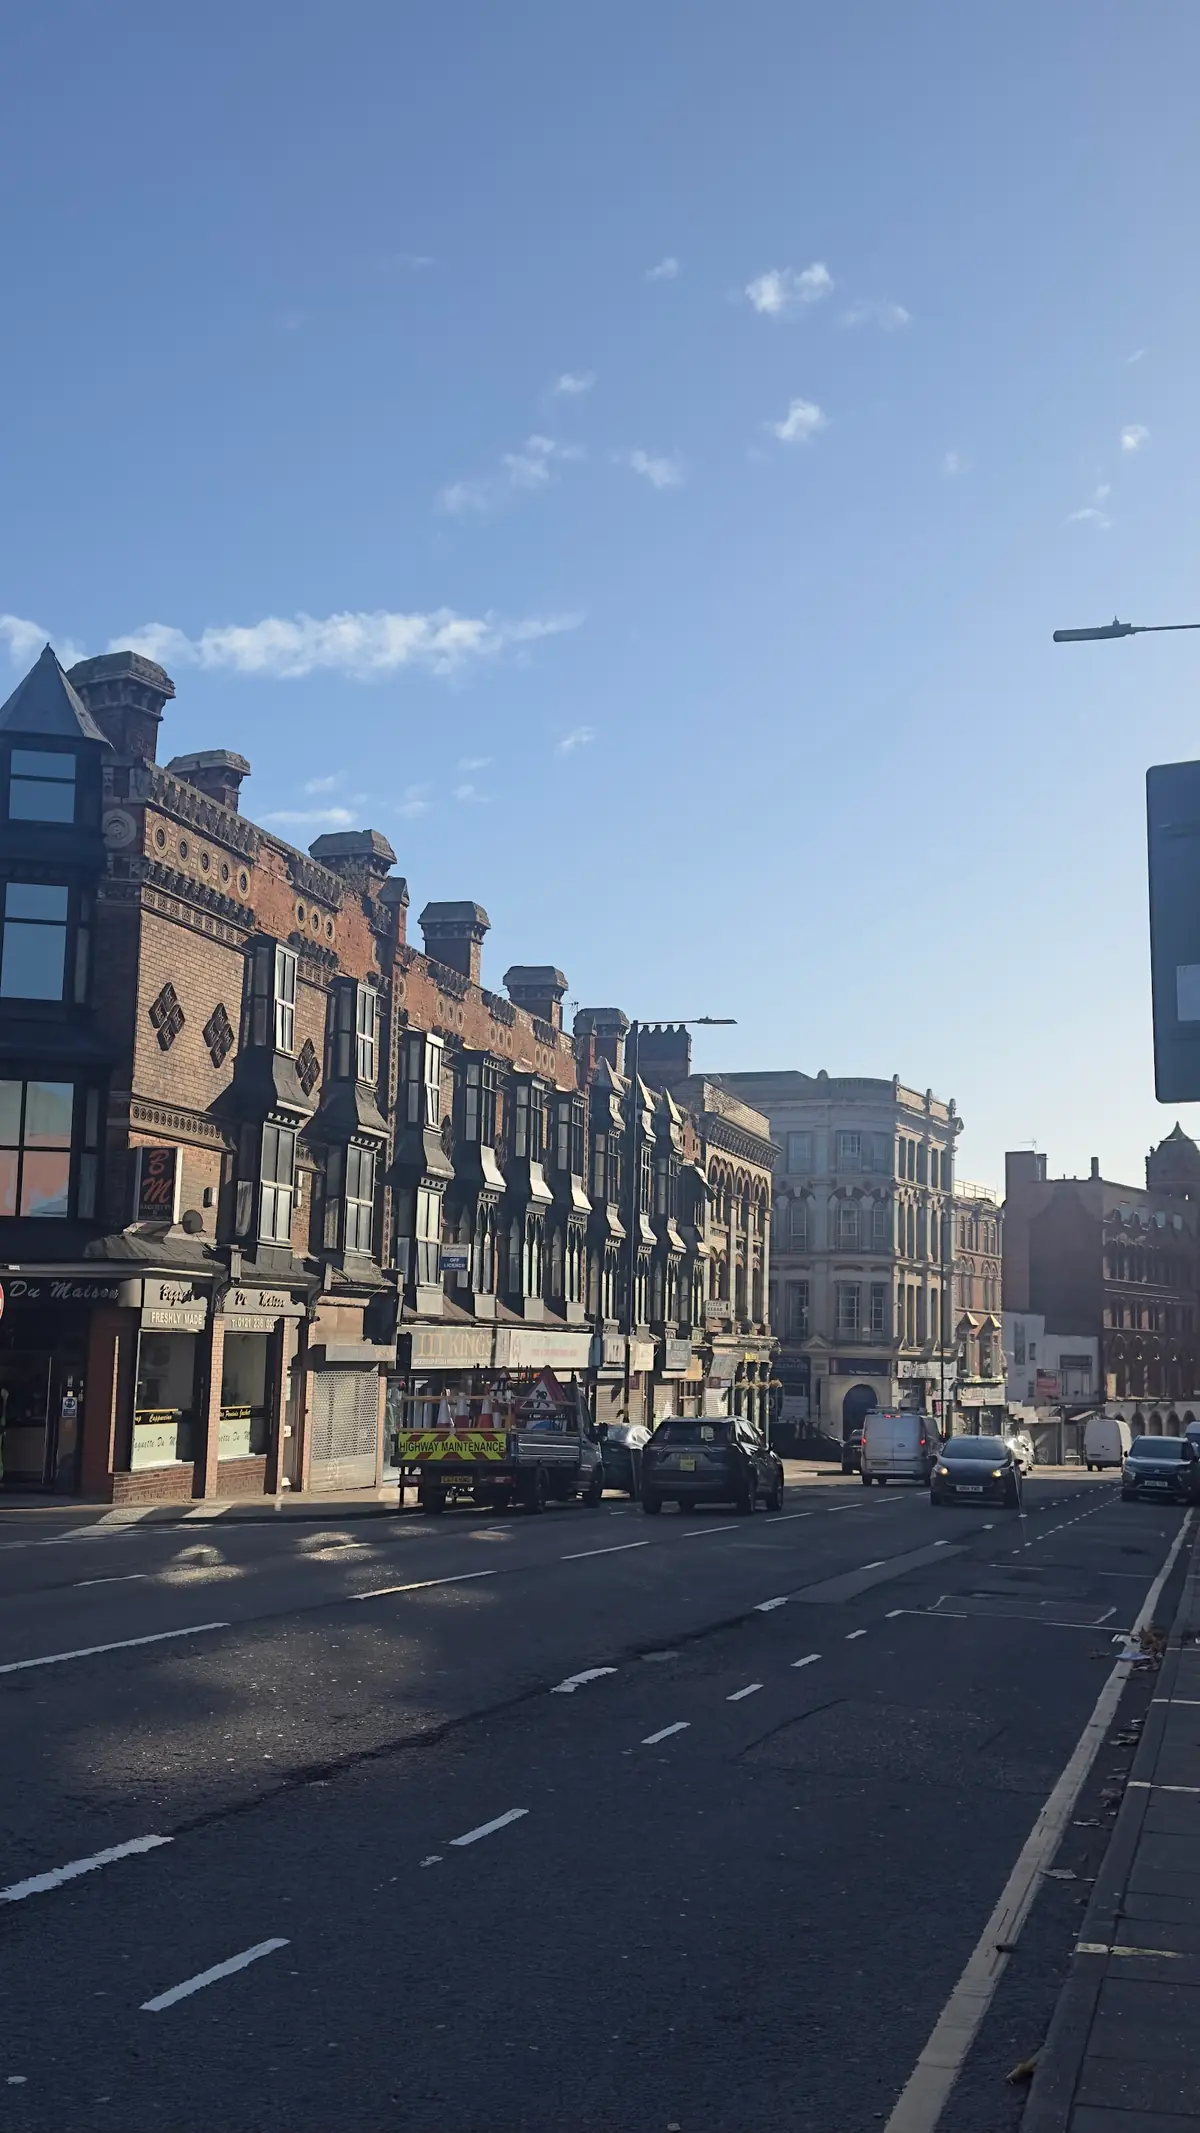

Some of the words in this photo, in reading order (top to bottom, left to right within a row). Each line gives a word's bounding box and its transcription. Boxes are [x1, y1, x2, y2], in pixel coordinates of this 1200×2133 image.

[148, 1149, 170, 1175] B
[142, 1177, 173, 1203] M
[9, 1280, 41, 1299] Du
[48, 1280, 119, 1299] Maison
[151, 1312, 181, 1324] FRESHLY
[184, 1314, 204, 1325] MADE
[418, 1333, 444, 1357] III
[448, 1334, 492, 1357] KINGS
[399, 1442, 439, 1452] HIGHWAY
[441, 1441, 505, 1452] MAINTENANCE
